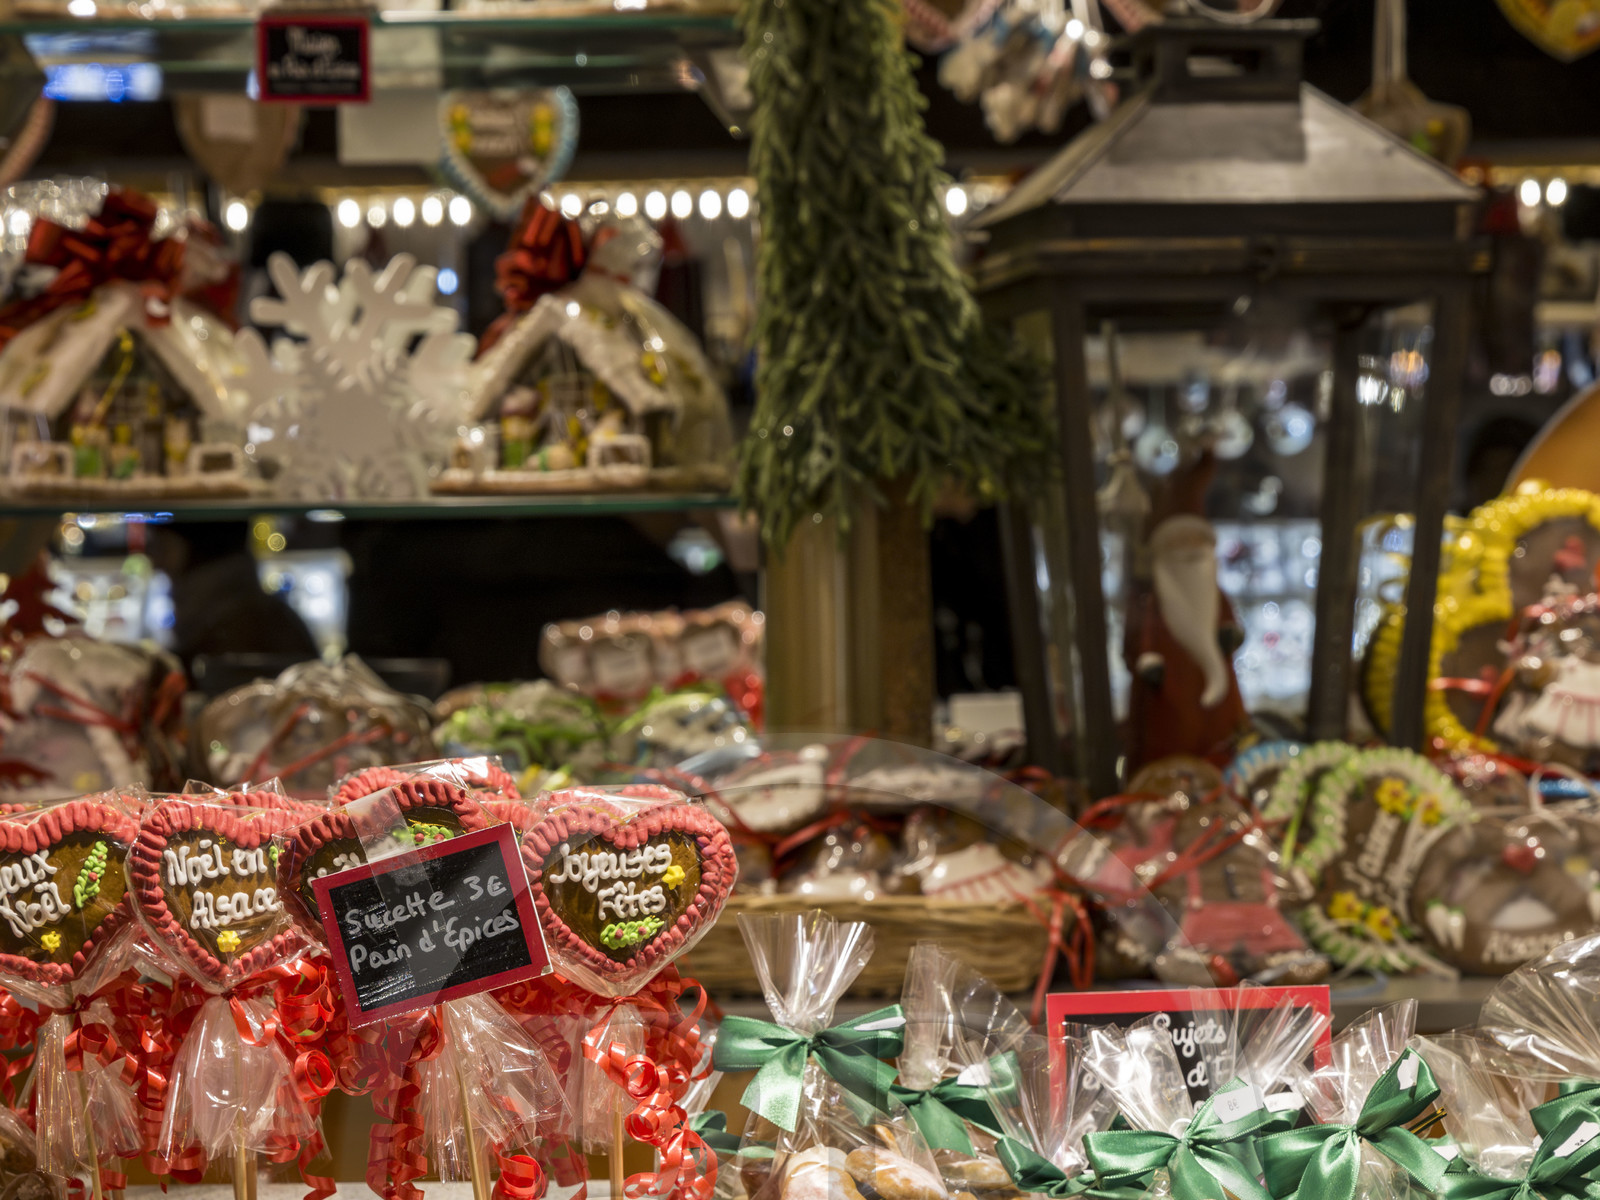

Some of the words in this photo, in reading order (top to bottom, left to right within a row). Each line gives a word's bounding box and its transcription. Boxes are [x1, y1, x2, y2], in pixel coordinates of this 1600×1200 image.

[0, 849, 58, 900] eux
[164, 839, 230, 886] Noël
[231, 848, 268, 876] en
[550, 843, 673, 893] Joyeuses
[0, 881, 72, 938] Noël
[190, 887, 282, 929] Alsace
[344, 889, 455, 935] Sucette
[597, 881, 667, 921] Fêtes
[350, 938, 413, 973] Pain
[1153, 1013, 1227, 1058] Sujets
